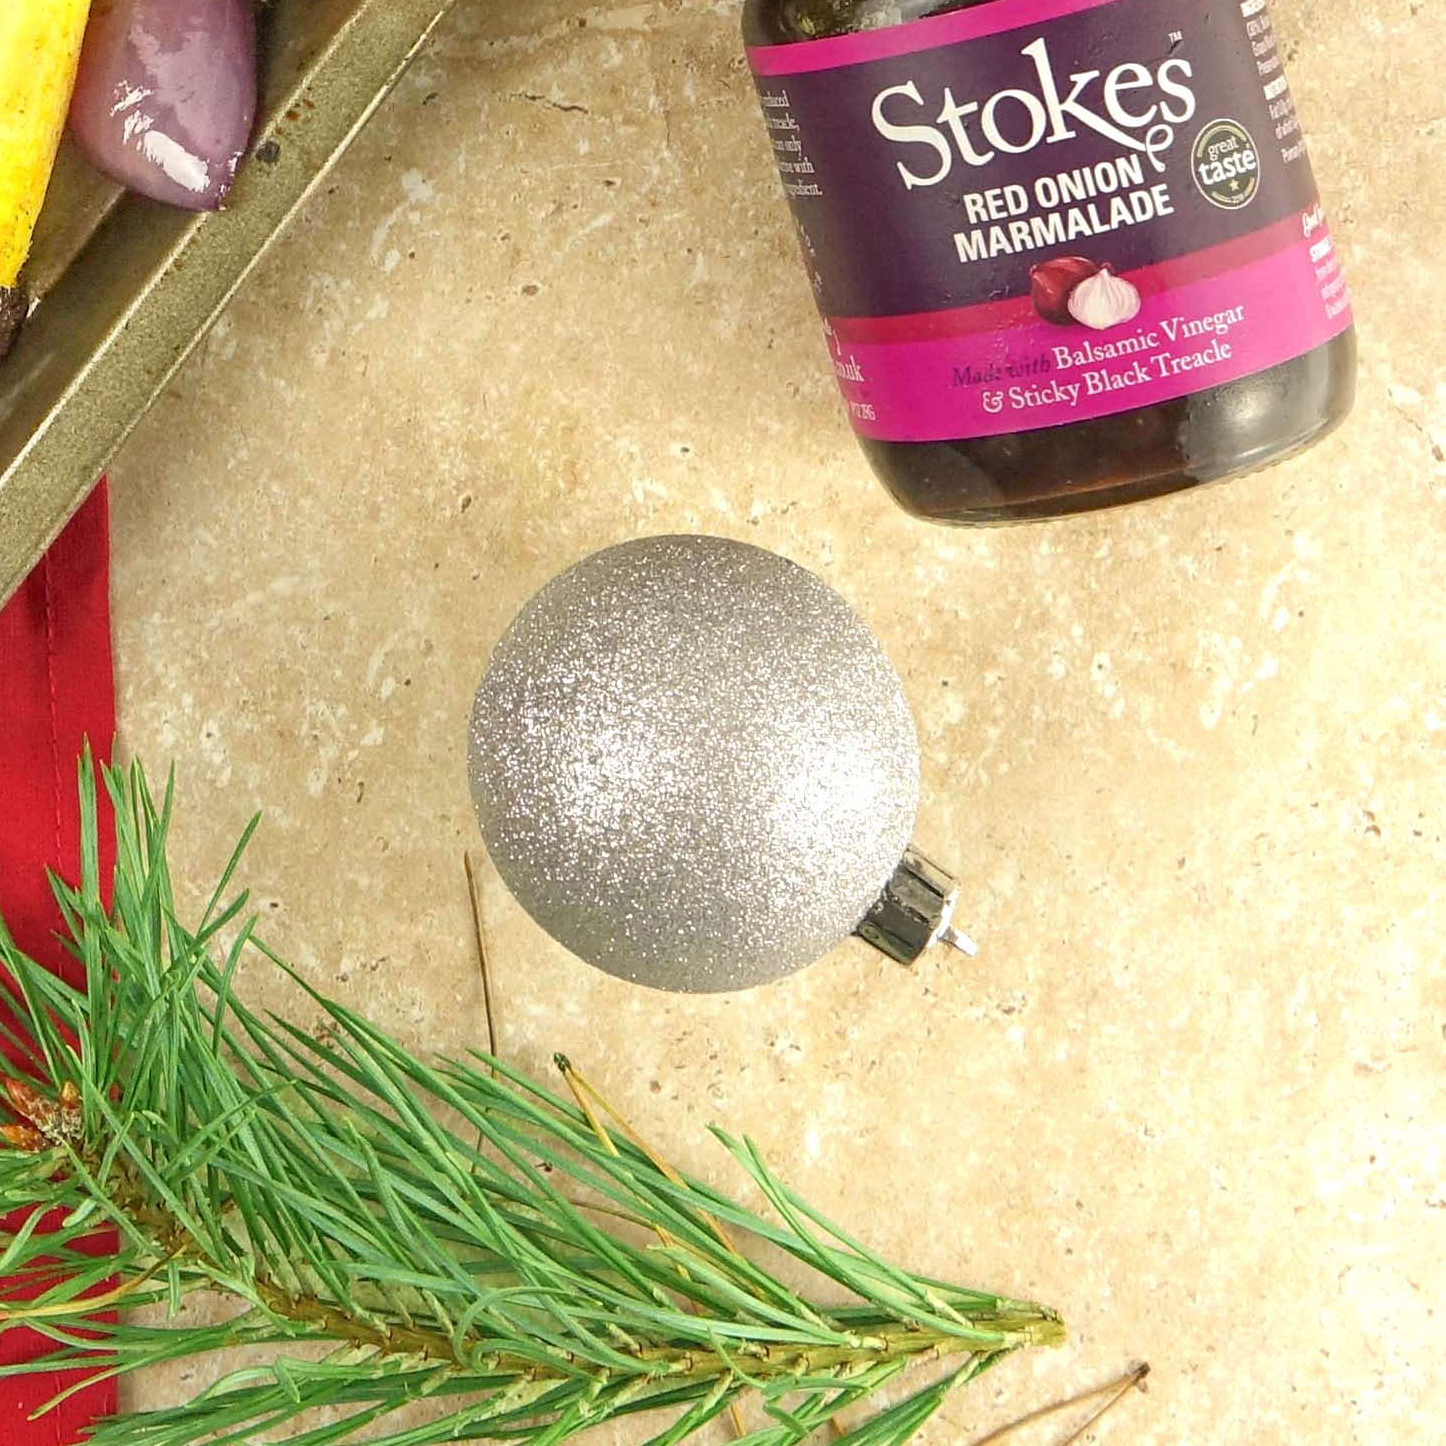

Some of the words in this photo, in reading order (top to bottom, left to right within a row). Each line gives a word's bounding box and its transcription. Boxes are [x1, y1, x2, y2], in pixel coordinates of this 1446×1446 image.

[871, 37, 1196, 189] Stokes
[1207, 136, 1239, 161] great
[963, 184, 1029, 224] RED
[1034, 154, 1144, 201] ONION
[1198, 149, 1257, 185] taste
[954, 184, 1174, 263] MARMALADE
[953, 364, 1001, 387] Made
[1004, 354, 1051, 377] with
[1052, 329, 1160, 371] Balsamic
[1159, 304, 1246, 342] Vinegar
[982, 391, 1003, 413] &
[1009, 377, 1081, 411] Sticky
[1086, 363, 1152, 396] Black
[1150, 339, 1233, 378] Treacle
